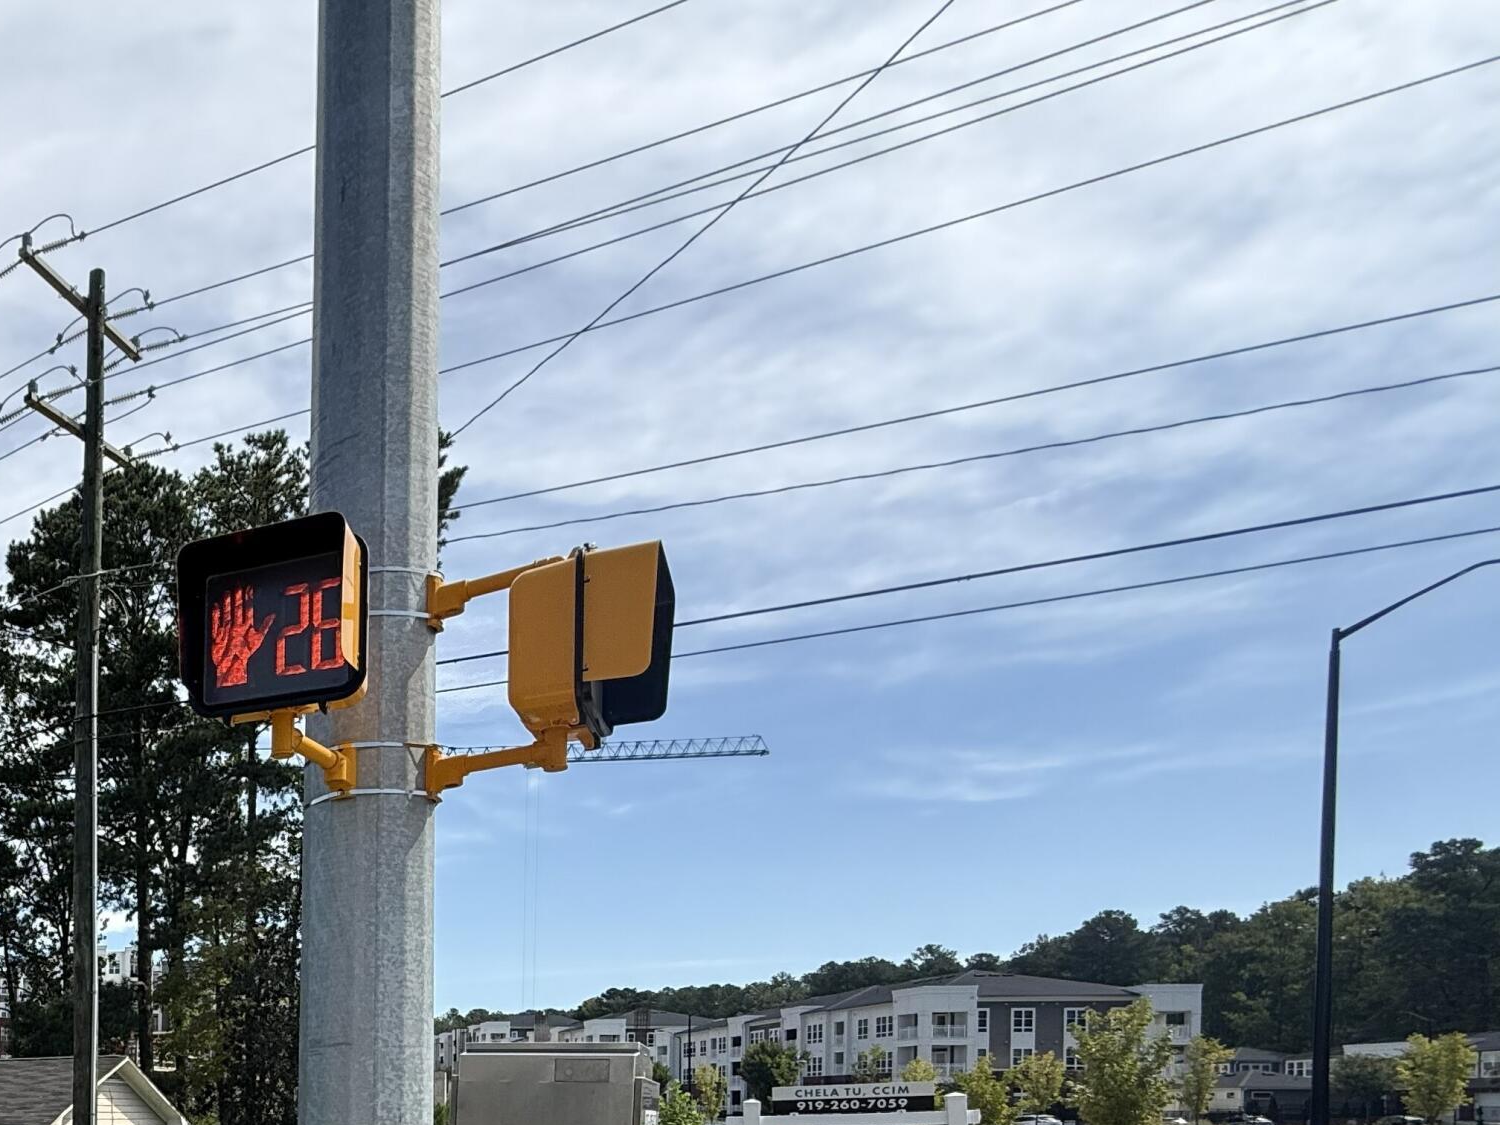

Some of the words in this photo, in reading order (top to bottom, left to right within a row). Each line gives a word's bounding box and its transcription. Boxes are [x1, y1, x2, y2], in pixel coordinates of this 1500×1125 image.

[276, 577, 345, 676] 26
[795, 1088, 839, 1098] CHELA
[844, 1087, 866, 1097] TU,
[872, 1086, 909, 1095] CCIM
[797, 1098, 908, 1111] 919-260-7059
